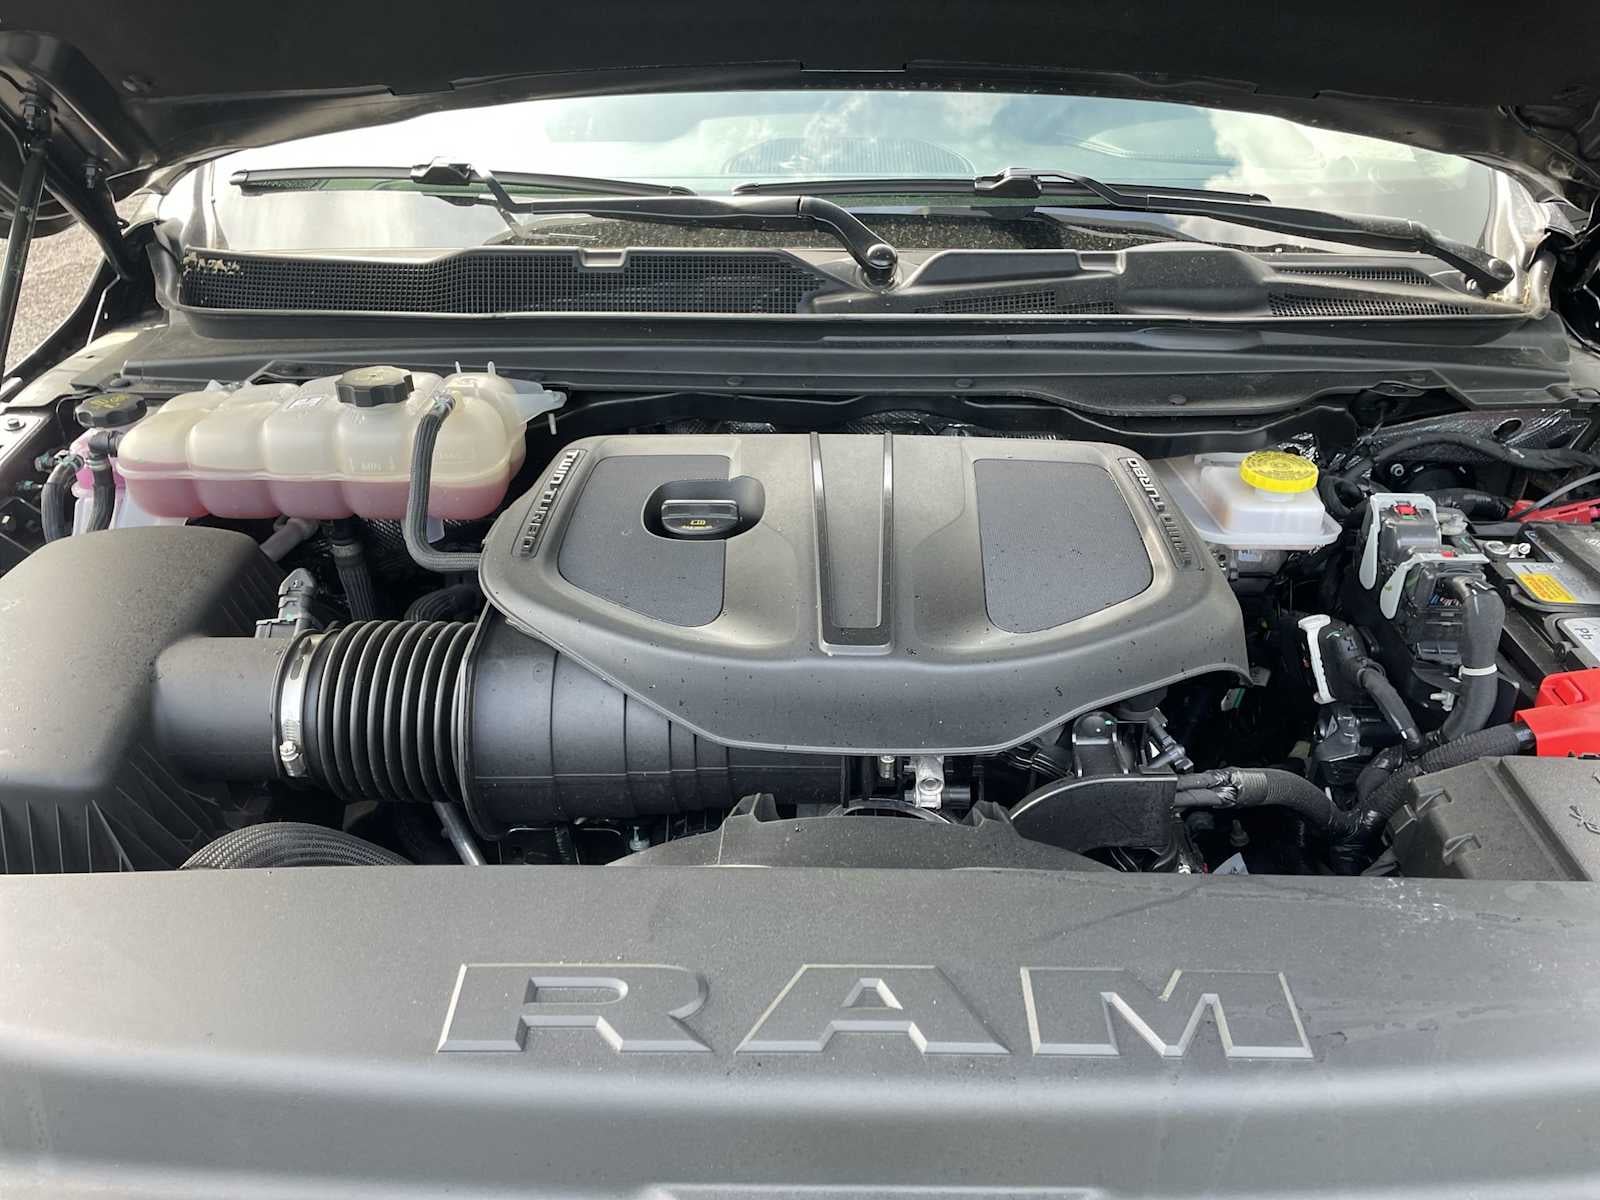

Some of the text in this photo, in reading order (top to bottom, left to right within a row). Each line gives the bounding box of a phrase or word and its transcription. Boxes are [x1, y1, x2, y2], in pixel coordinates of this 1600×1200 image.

[520, 449, 580, 557] TWIN TURBO
[1127, 457, 1166, 513] TURBO
[436, 962, 1316, 1061] RAM
